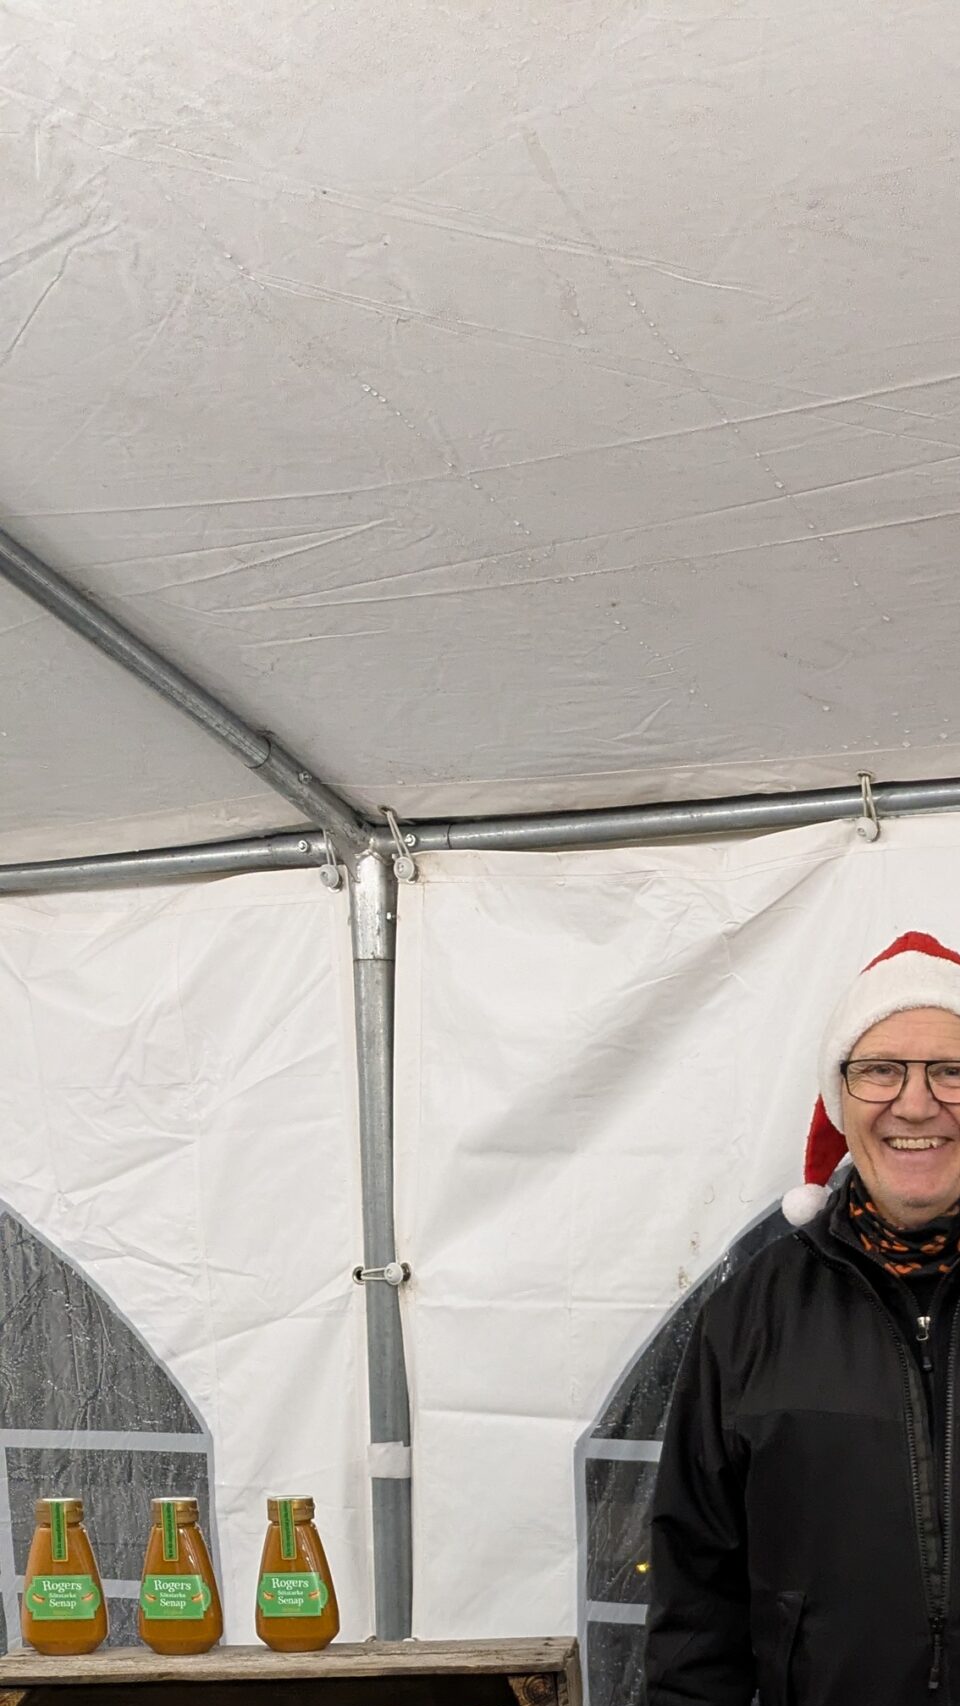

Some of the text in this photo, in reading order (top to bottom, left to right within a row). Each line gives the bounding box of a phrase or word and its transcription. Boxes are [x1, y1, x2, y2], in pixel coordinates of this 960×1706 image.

[43, 1580, 82, 1592] Rogers
[154, 1580, 191, 1592] Rogers
[272, 1578, 309, 1590] Rogers
[50, 1599, 76, 1610] Senap
[160, 1599, 186, 1610] Senap
[278, 1596, 304, 1606] Senap
